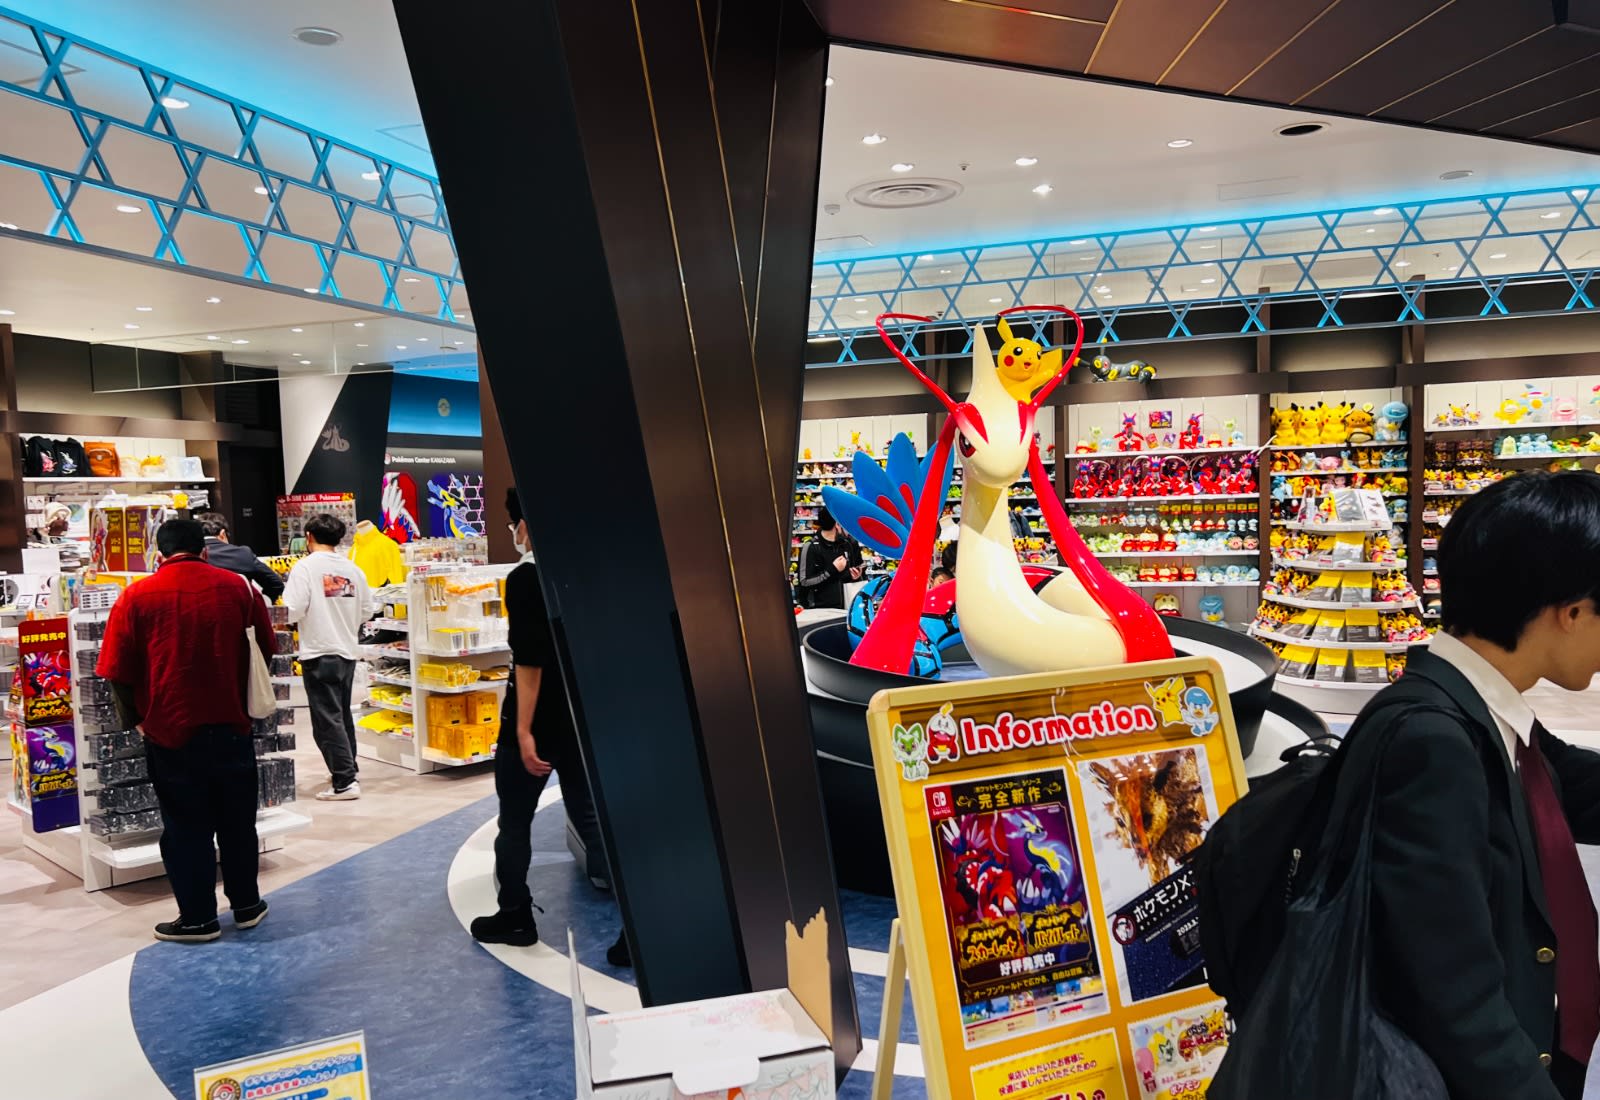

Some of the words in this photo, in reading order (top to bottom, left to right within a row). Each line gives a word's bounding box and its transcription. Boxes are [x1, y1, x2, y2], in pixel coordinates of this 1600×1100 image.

[962, 702, 1155, 753] Information
[978, 786, 1041, 809] 完全新作
